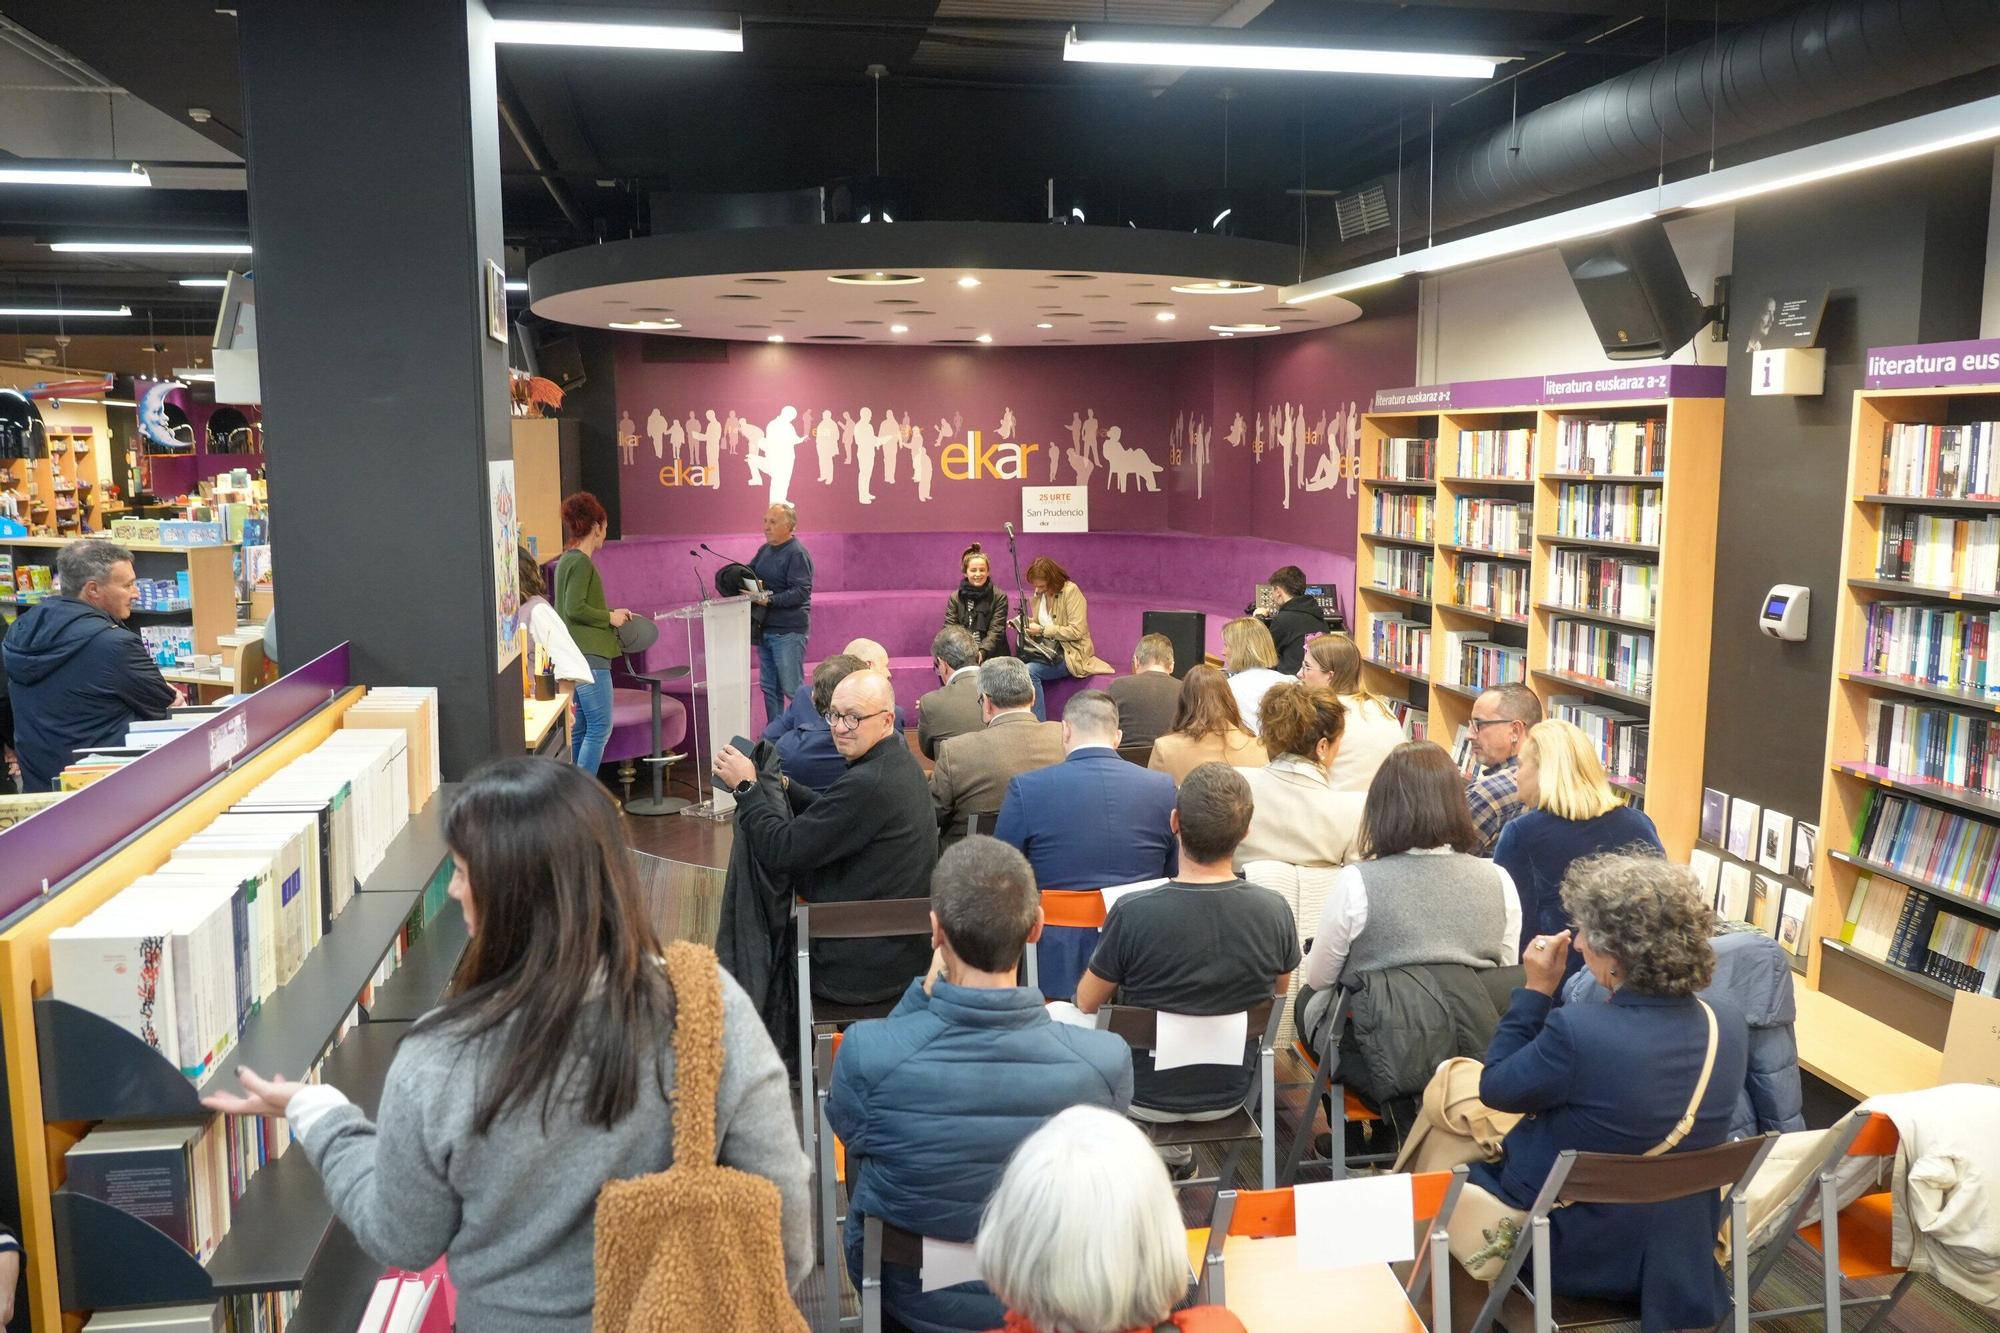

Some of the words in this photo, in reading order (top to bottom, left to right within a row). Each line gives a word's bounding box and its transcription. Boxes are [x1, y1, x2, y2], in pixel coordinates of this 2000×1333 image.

[1869, 355, 1957, 377] literatura
[1962, 352, 2000, 371] eus
[1546, 379, 1593, 395] literatura
[1595, 375, 1645, 392] euskaraz
[1647, 375, 1667, 388] a-z
[1375, 393, 1406, 407] literatura
[1407, 391, 1438, 404] euskaraz
[1439, 391, 1451, 402] a-z
[941, 430, 1039, 480] elkar
[659, 458, 716, 487] elkar
[1039, 493, 1049, 501] 25
[1050, 493, 1072, 501] URTE
[1026, 508, 1042, 518] San
[1043, 507, 1084, 517] Prudencio
